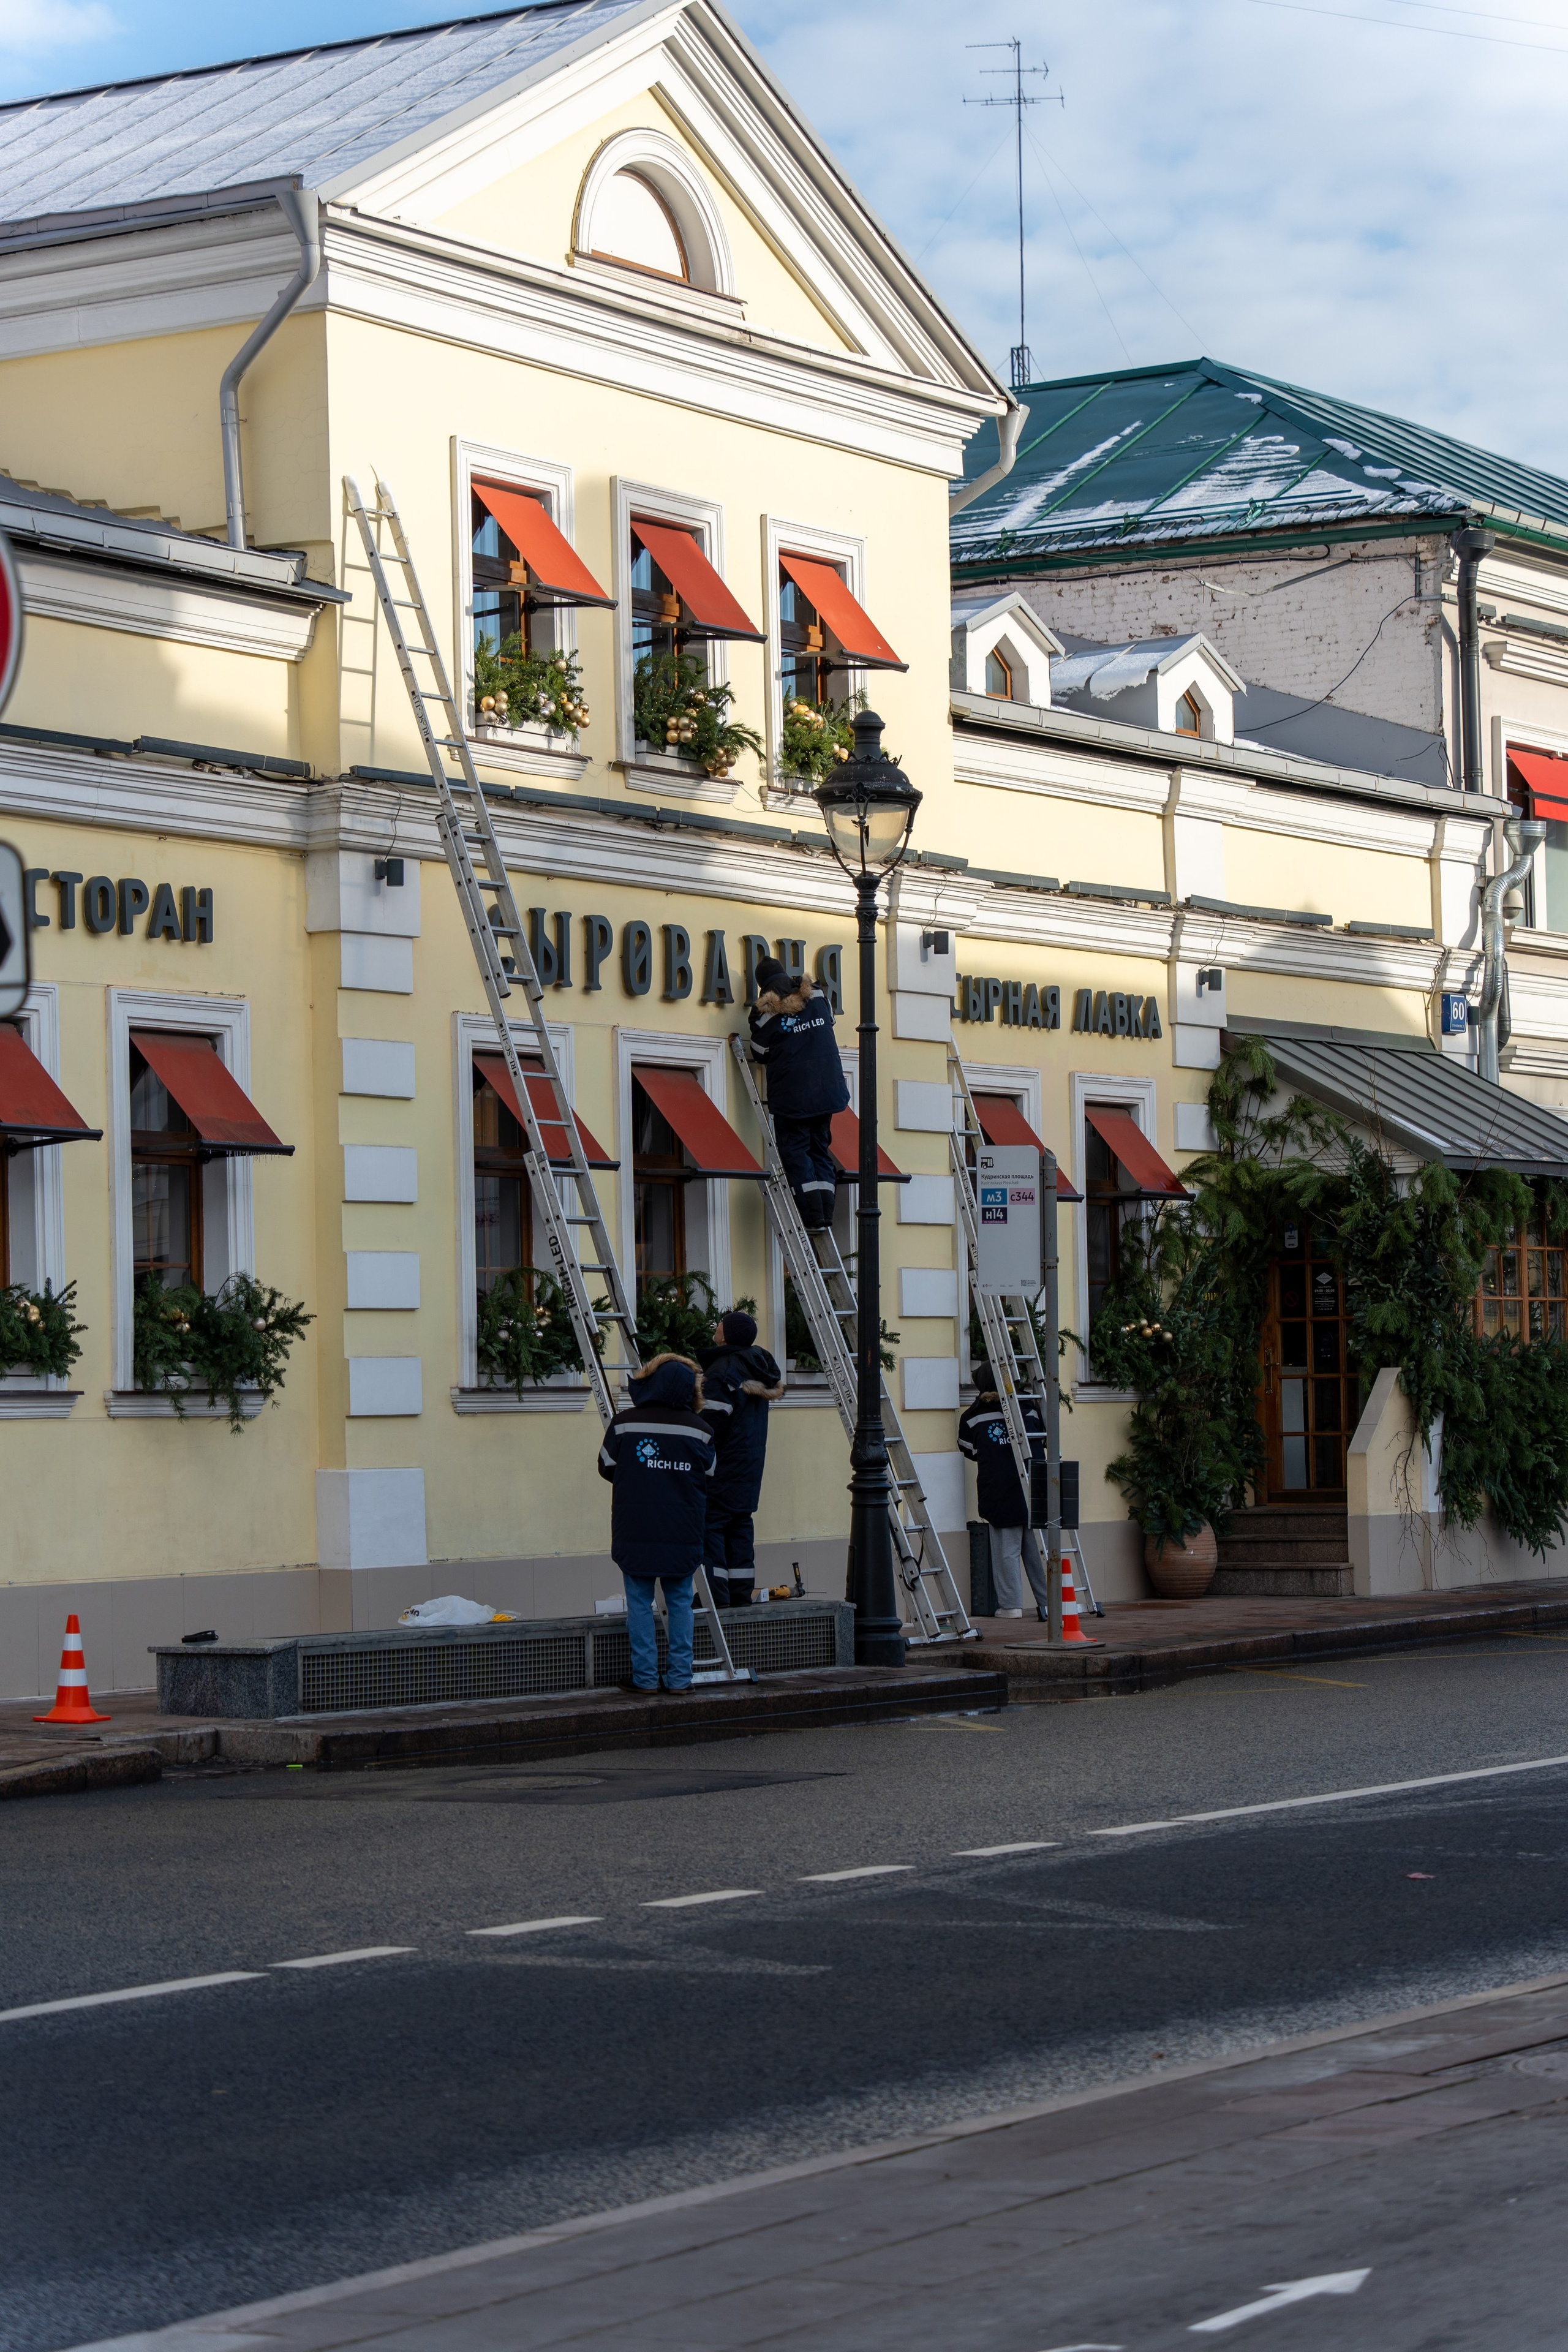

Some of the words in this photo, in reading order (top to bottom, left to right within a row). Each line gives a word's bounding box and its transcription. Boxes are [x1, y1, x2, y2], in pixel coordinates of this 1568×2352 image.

[412, 695, 430, 737] RL-SC-113
[1074, 988, 1163, 1039] ЛАВКА
[1452, 1001, 1464, 1020] 60
[793, 1021, 810, 1033] RICH
[812, 1018, 824, 1027] LED
[499, 1029, 518, 1069] RL-SC-113
[986, 1191, 1002, 1202] м3
[1010, 1191, 1034, 1201] с344
[986, 1208, 1004, 1219] н14
[588, 1369, 606, 1412] RL-SC-113
[647, 1459, 671, 1469] RICH
[674, 1461, 692, 1471] LED
